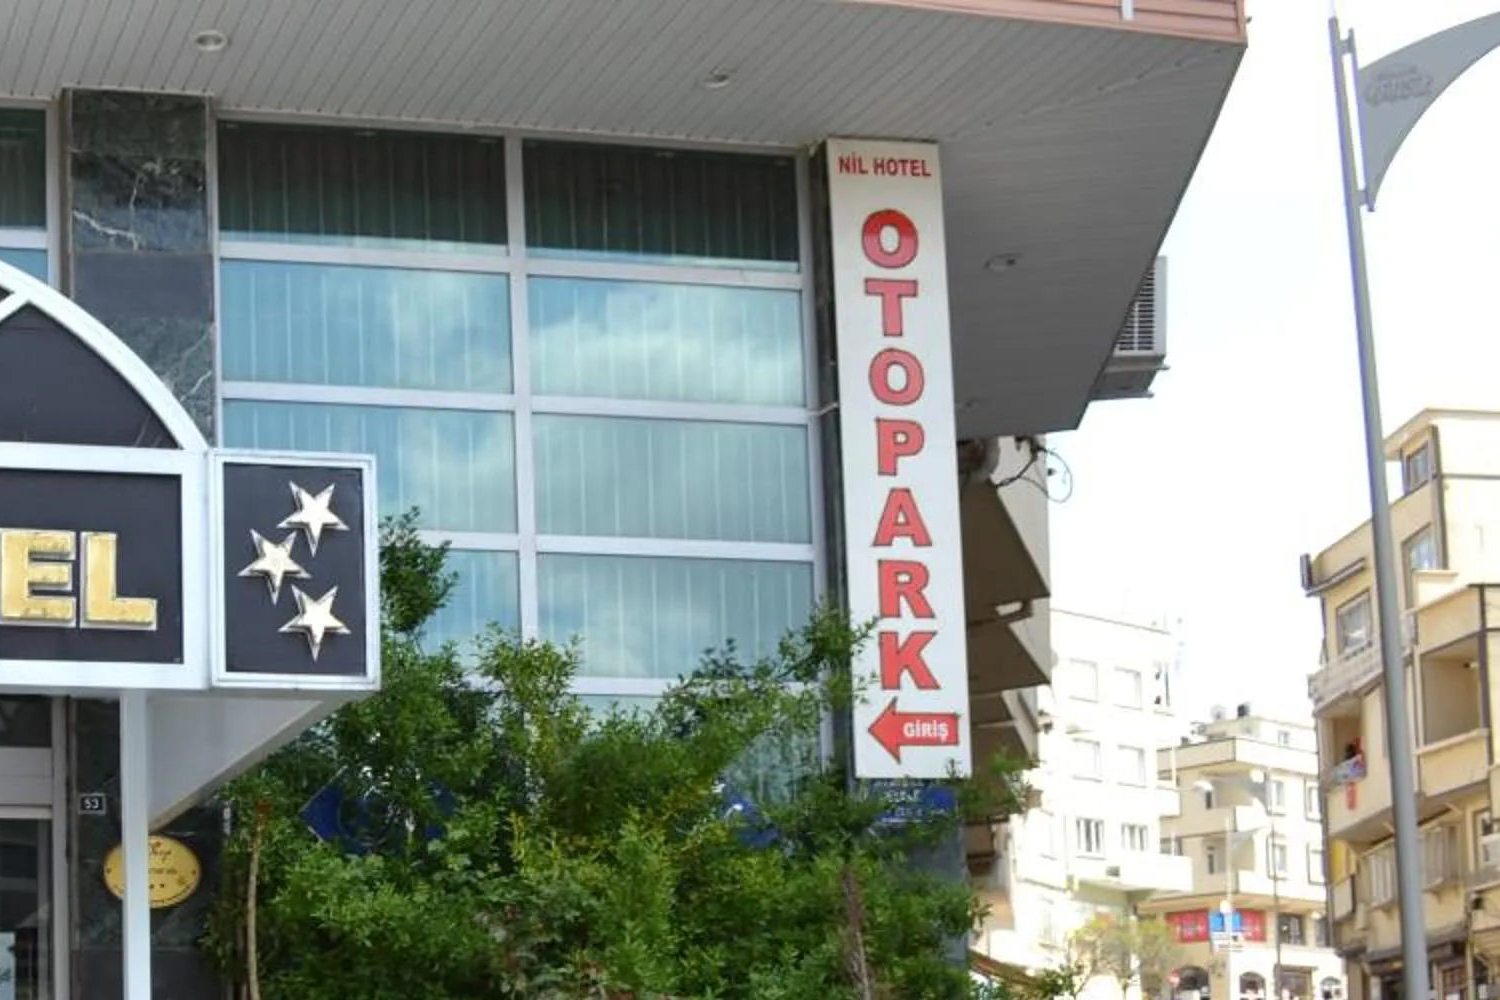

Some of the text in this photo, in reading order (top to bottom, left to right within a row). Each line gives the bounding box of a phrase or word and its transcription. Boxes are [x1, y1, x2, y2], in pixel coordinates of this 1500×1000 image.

[837, 152, 931, 177] NİL HOTEL
[861, 209, 940, 690] OTOPARK
[902, 719, 949, 743] GİRİŞ
[83, 798, 100, 809] 53
